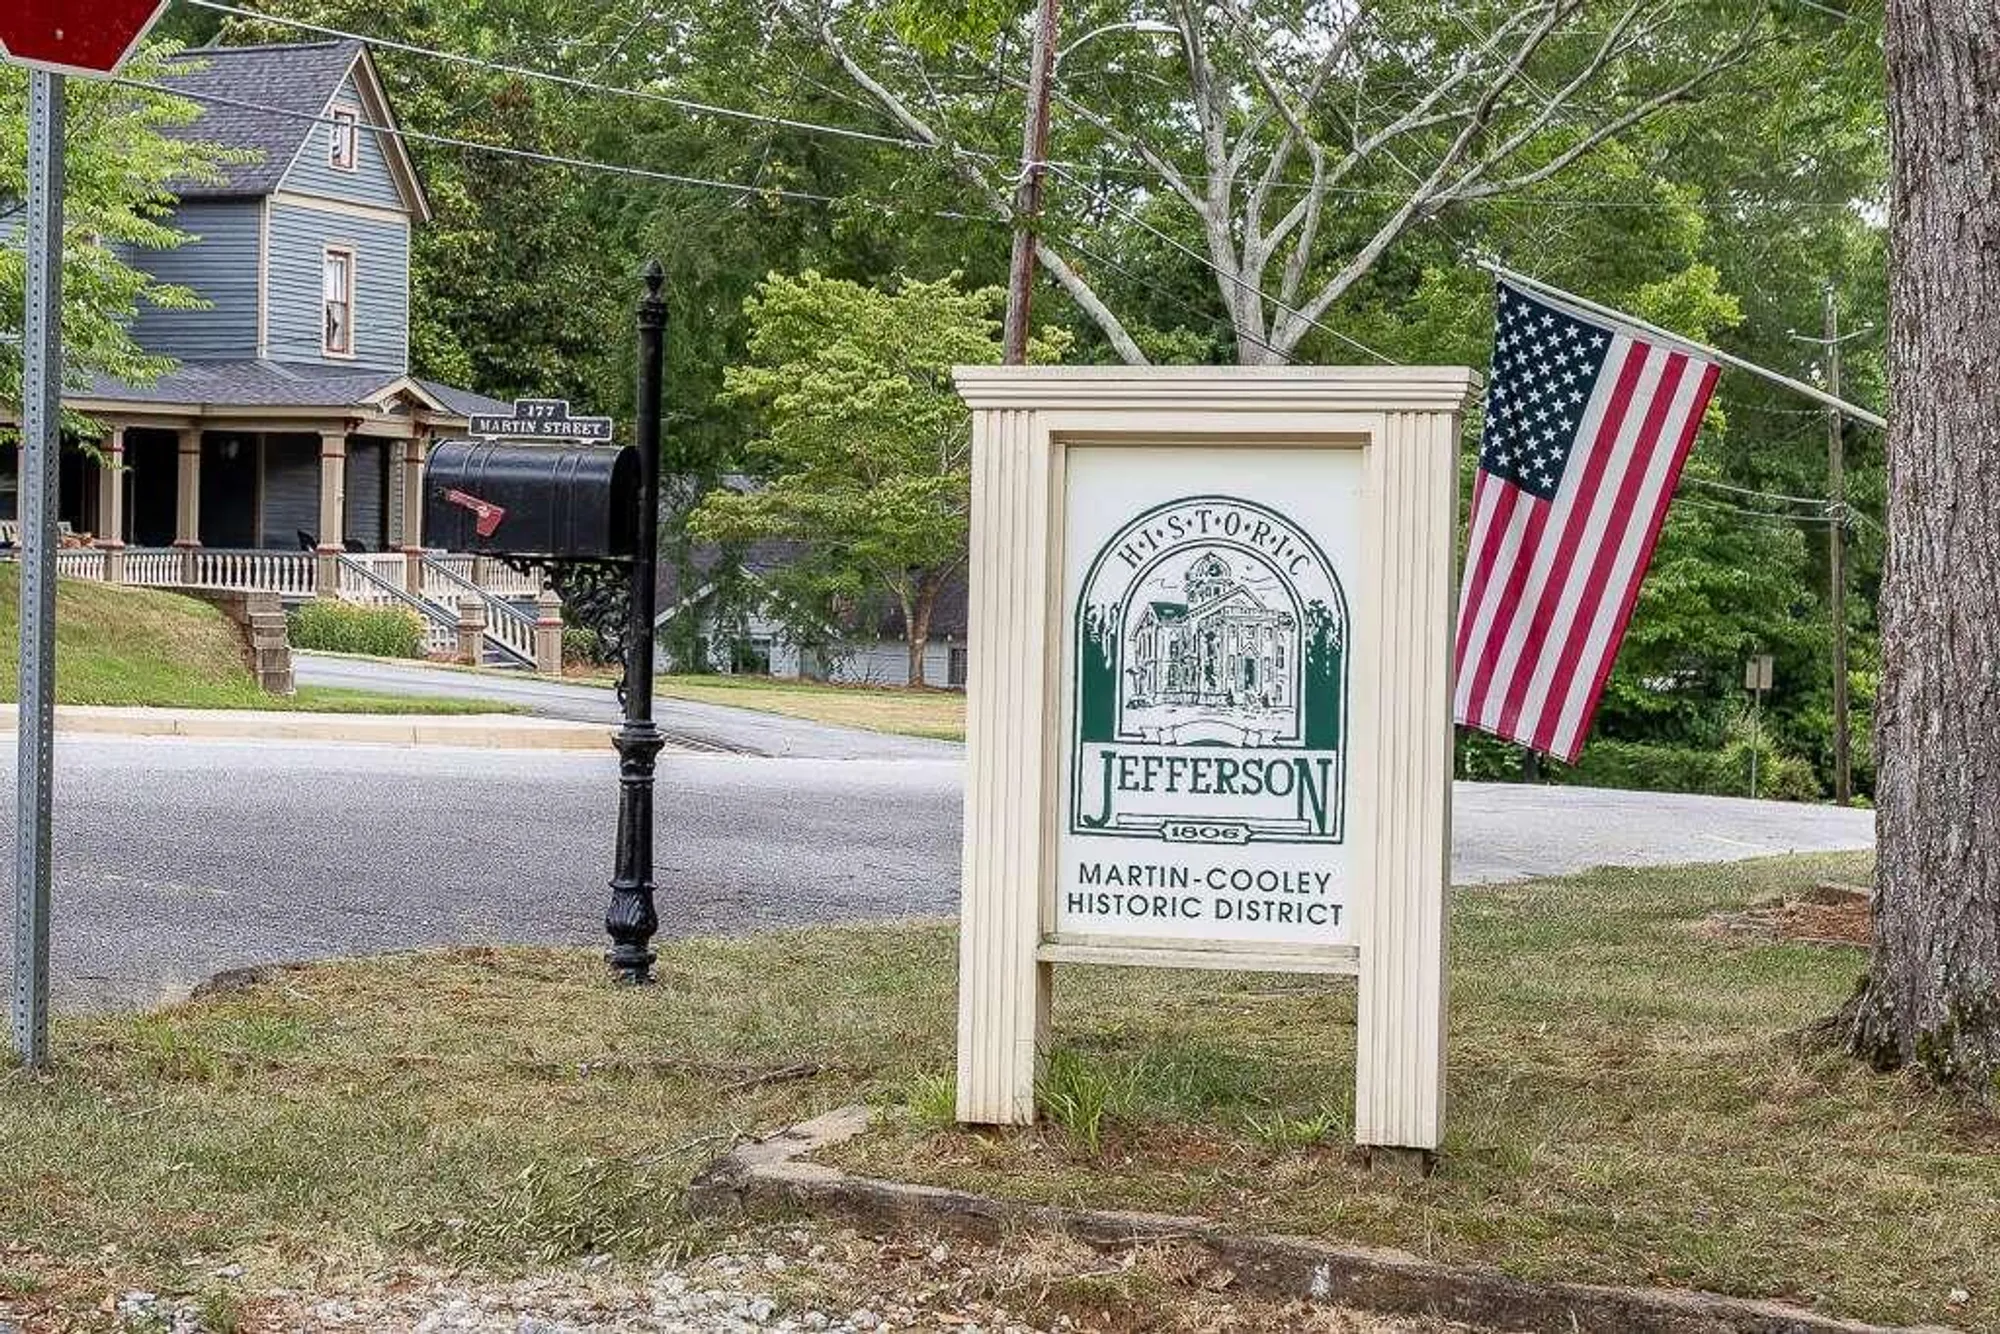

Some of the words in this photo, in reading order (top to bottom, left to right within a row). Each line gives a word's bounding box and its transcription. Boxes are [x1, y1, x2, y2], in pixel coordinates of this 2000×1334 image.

[527, 405, 555, 417] 177
[479, 419, 537, 433] MARTIN
[542, 421, 602, 436] STREET
[1083, 750, 1333, 836] JEFFERSON
[1170, 826, 1240, 840] 1806
[1078, 862, 1332, 895] MARTIN-COOLEY
[1067, 892, 1202, 919] HISTORIC
[1215, 899, 1344, 927] DISTRICT
